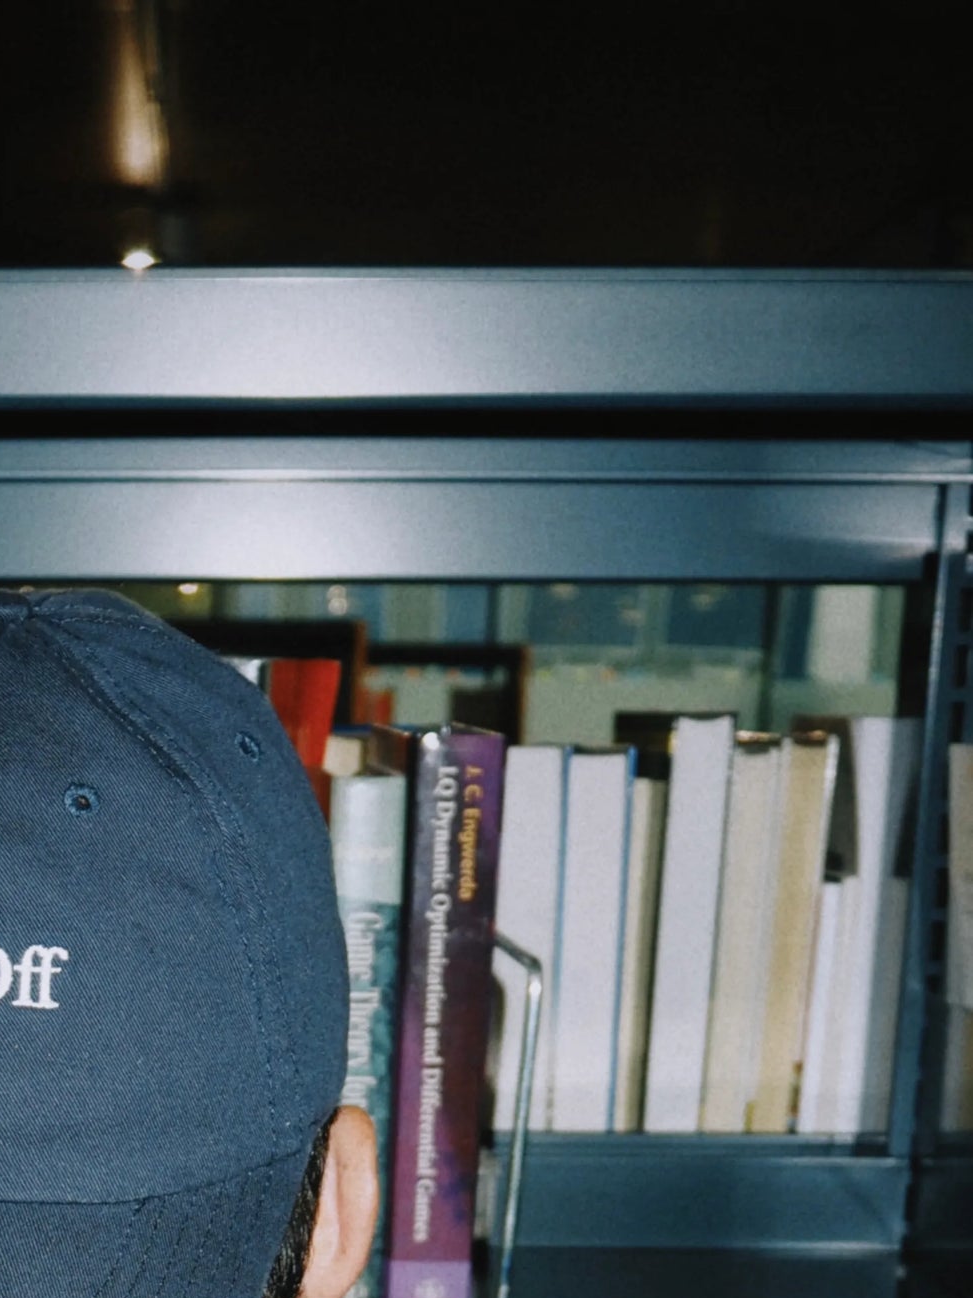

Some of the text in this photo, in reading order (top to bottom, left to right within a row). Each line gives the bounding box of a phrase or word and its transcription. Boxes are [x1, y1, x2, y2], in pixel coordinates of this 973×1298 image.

[431, 801, 457, 890] Dynamic
[458, 807, 482, 901] Engwerda
[347, 912, 384, 980] Game
[425, 893, 452, 1024] Optimization
[423, 1027, 444, 1065] and
[417, 1068, 444, 1177] Differential
[414, 1179, 436, 1243] Games
